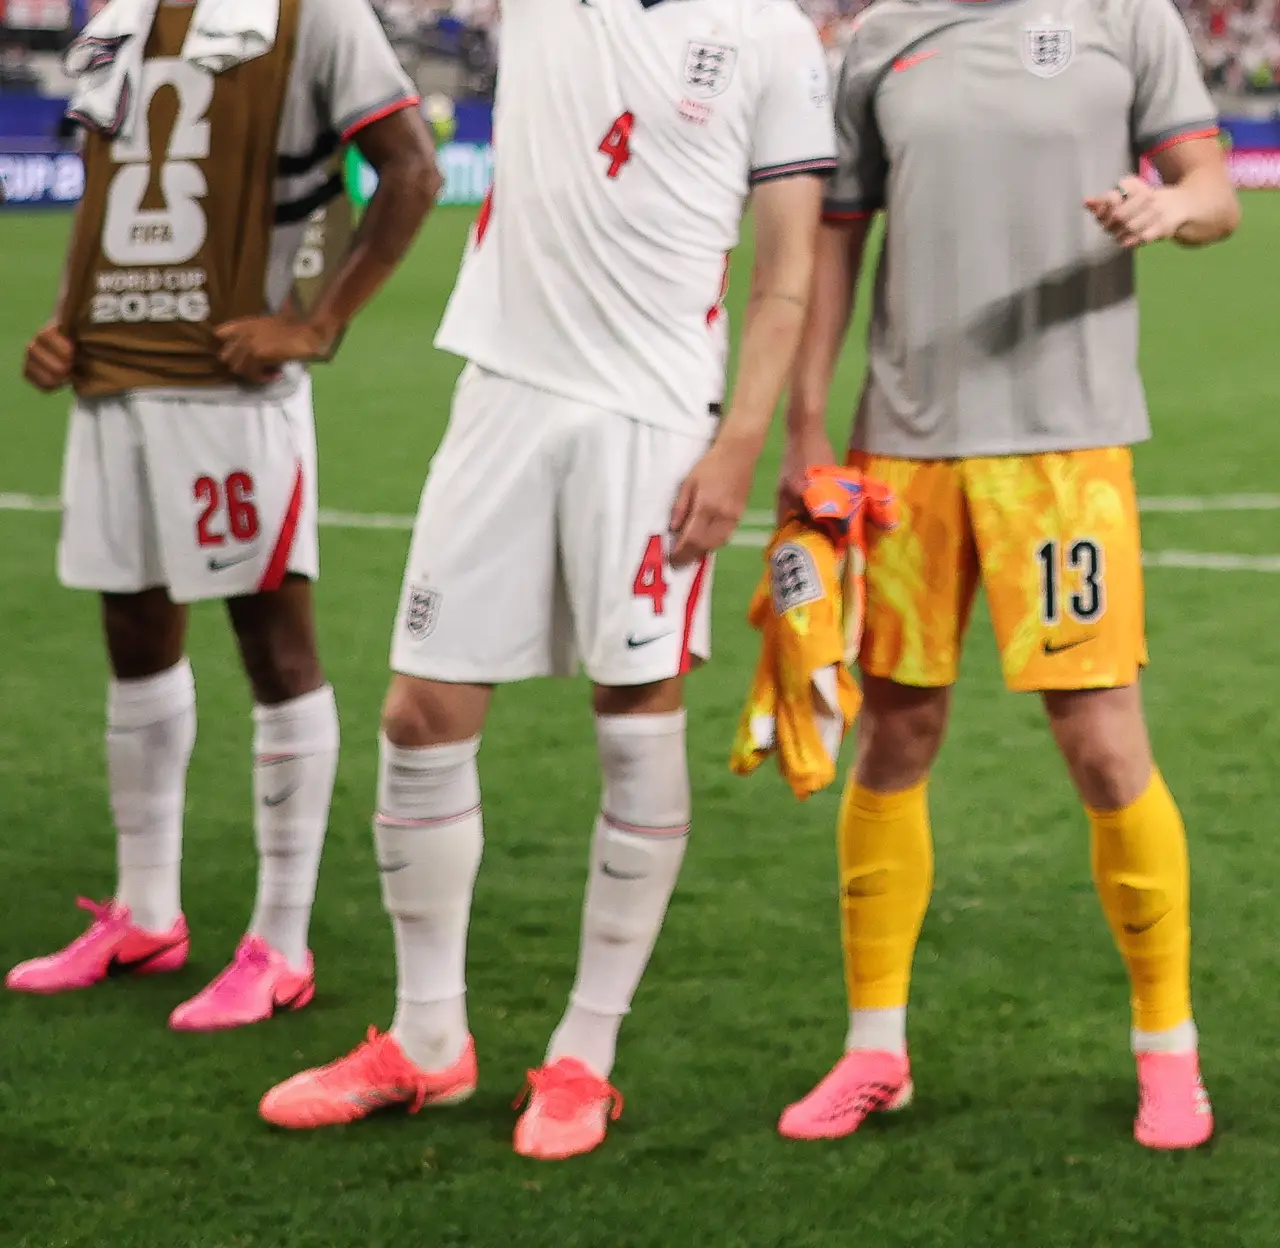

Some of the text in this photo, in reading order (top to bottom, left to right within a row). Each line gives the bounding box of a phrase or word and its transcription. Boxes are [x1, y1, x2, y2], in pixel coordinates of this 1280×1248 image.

[598, 110, 635, 178] 4
[90, 290, 210, 323] 2026
[94, 267, 206, 292] WORLD CUP
[191, 470, 260, 547] 26
[632, 534, 667, 615] 4
[1037, 539, 1101, 621] 13
